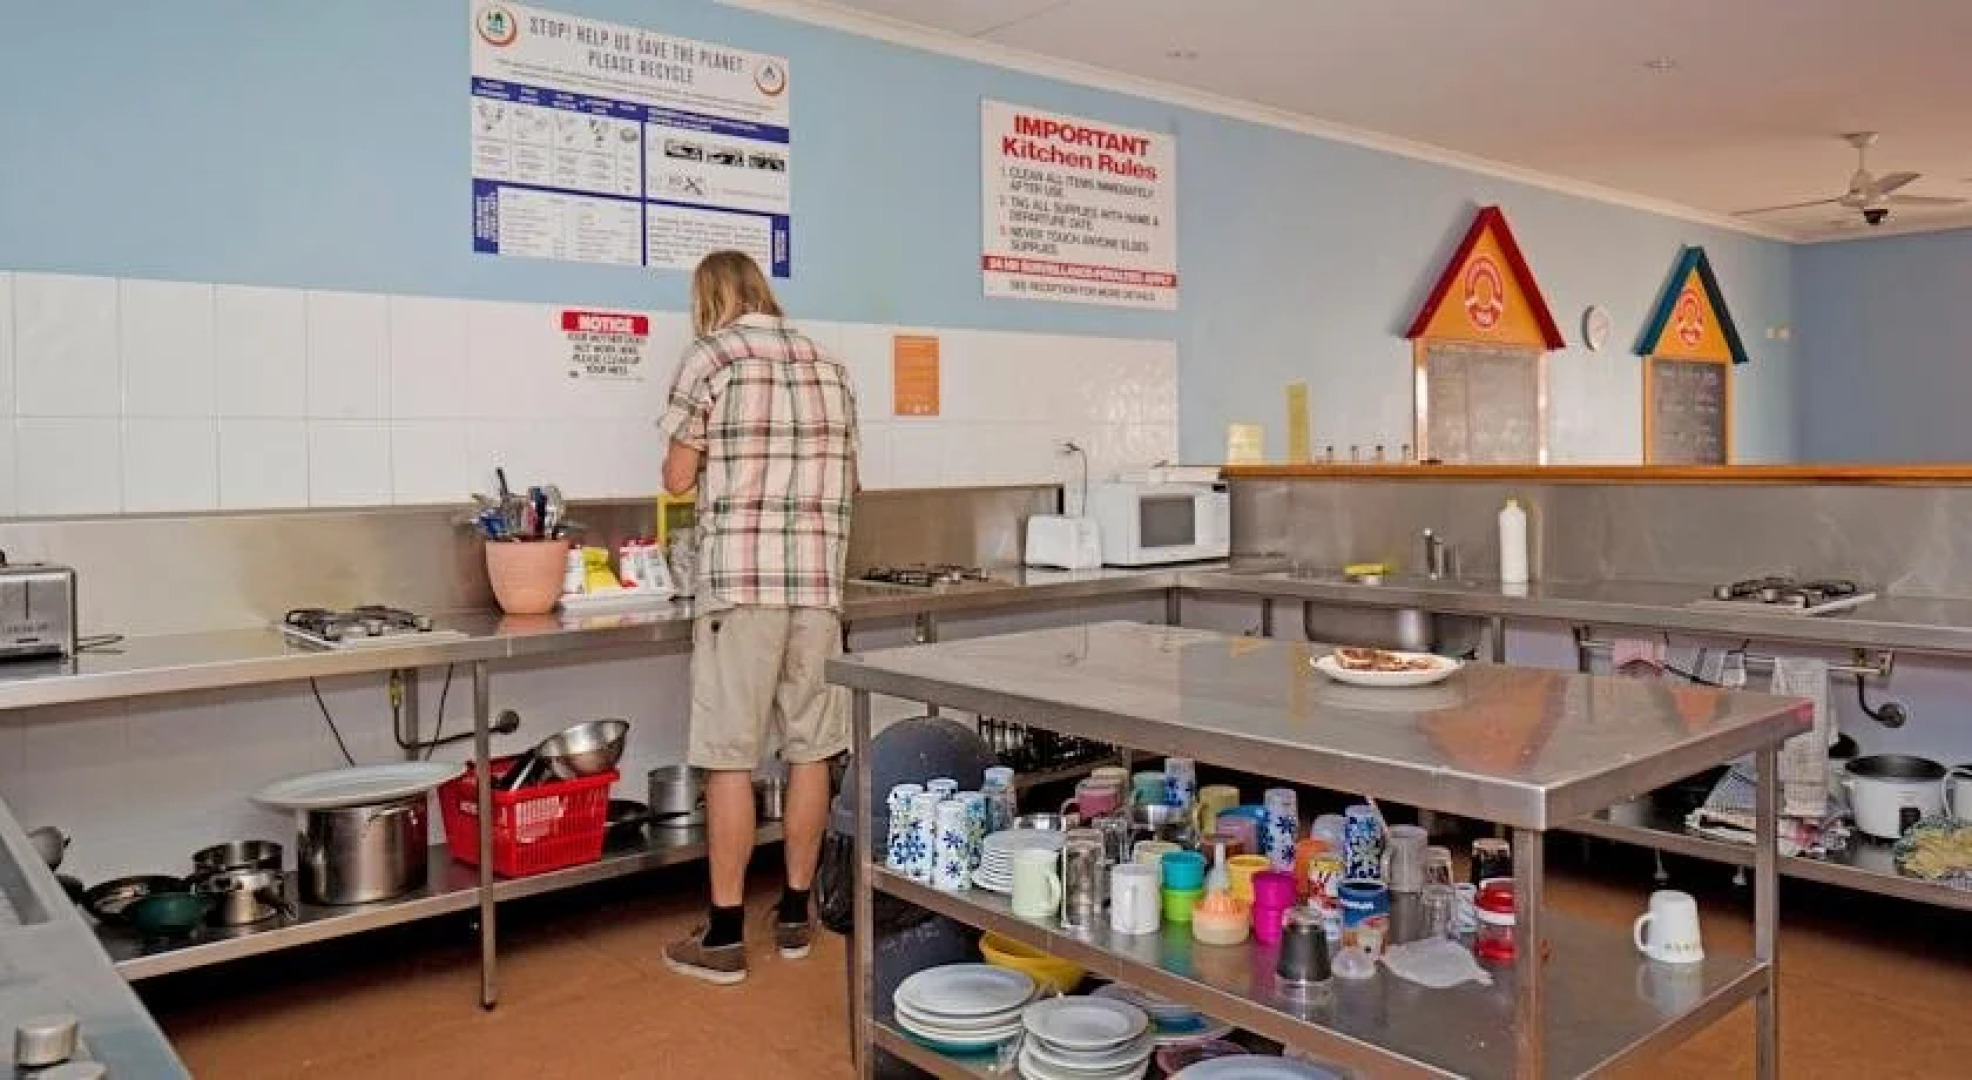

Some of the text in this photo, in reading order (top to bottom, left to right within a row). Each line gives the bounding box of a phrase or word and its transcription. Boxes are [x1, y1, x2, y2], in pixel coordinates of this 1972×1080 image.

[529, 16, 743, 71] STOP! HELP US SAVE THE PLANET
[588, 51, 635, 74] PLEASE
[640, 60, 693, 83] RECYCLE
[1015, 115, 1150, 156] IMPORTANT
[1003, 137, 1158, 181] Kitchen Rules
[1009, 167, 1043, 182] CLEAN
[1046, 172, 1064, 185] ALL
[1066, 174, 1094, 190] ITEMS
[1096, 179, 1155, 199] IMMEDIATELY
[1009, 181, 1042, 196] AFTER
[1009, 209, 1066, 227] DEPARTURE
[1033, 200, 1050, 213] ALL
[1053, 202, 1097, 219] SUPPLIES
[1010, 226, 1043, 241] NEVER
[1046, 230, 1079, 246] TOUCH
[579, 315, 633, 332] NOTICE
